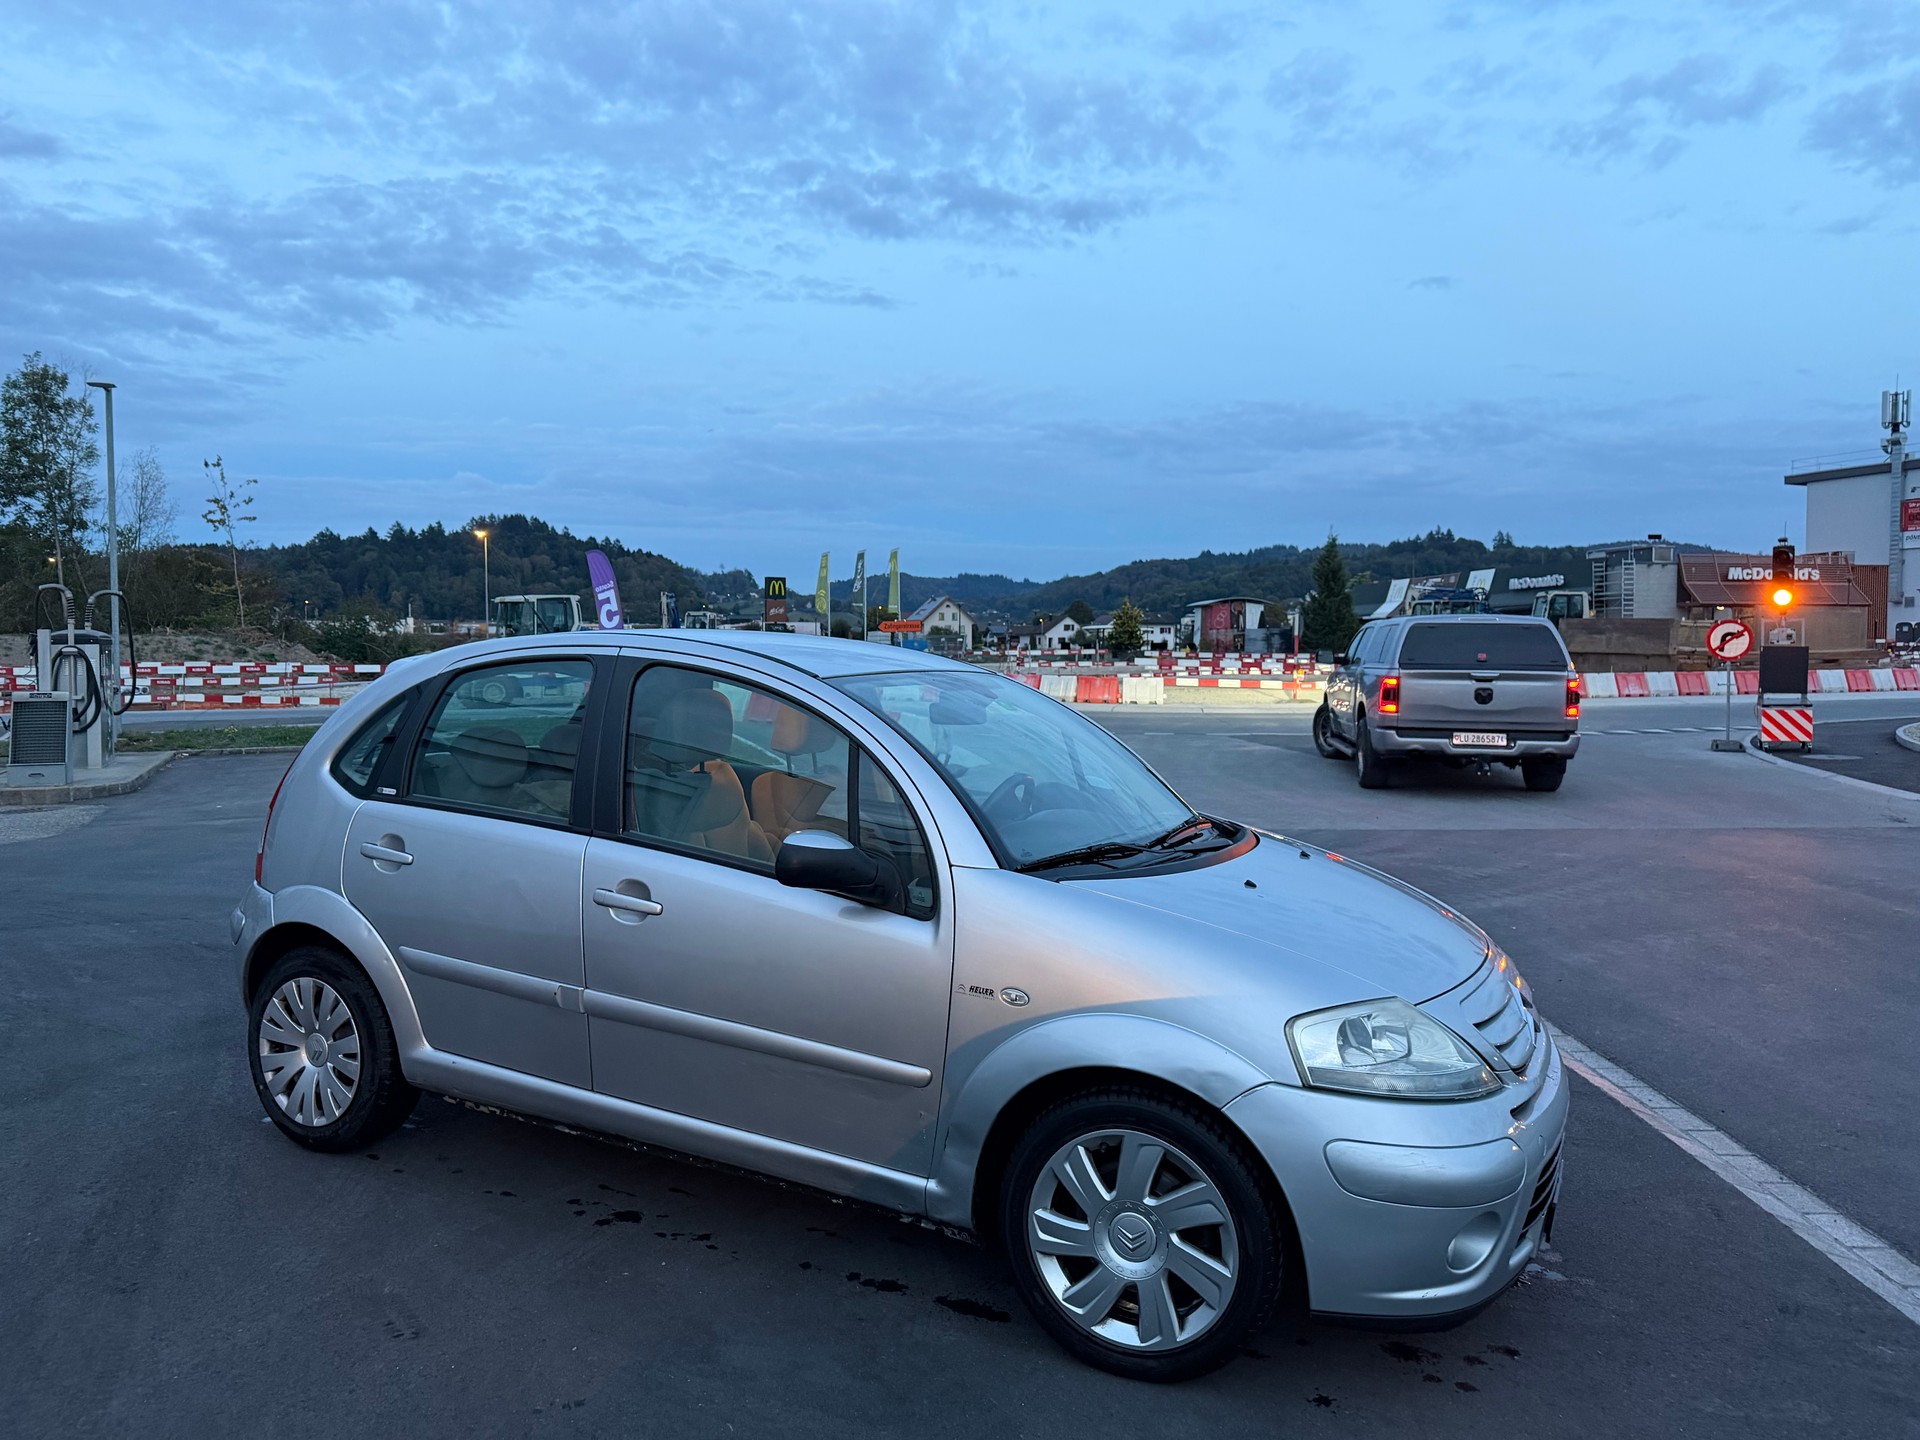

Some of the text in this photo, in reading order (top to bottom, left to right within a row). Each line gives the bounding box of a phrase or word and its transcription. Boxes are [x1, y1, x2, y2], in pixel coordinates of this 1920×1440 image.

[1727, 566, 1820, 581] McDold's
[1508, 574, 1565, 590] McDonald's
[1459, 734, 1469, 743] LU
[969, 985, 995, 997] HELLER
